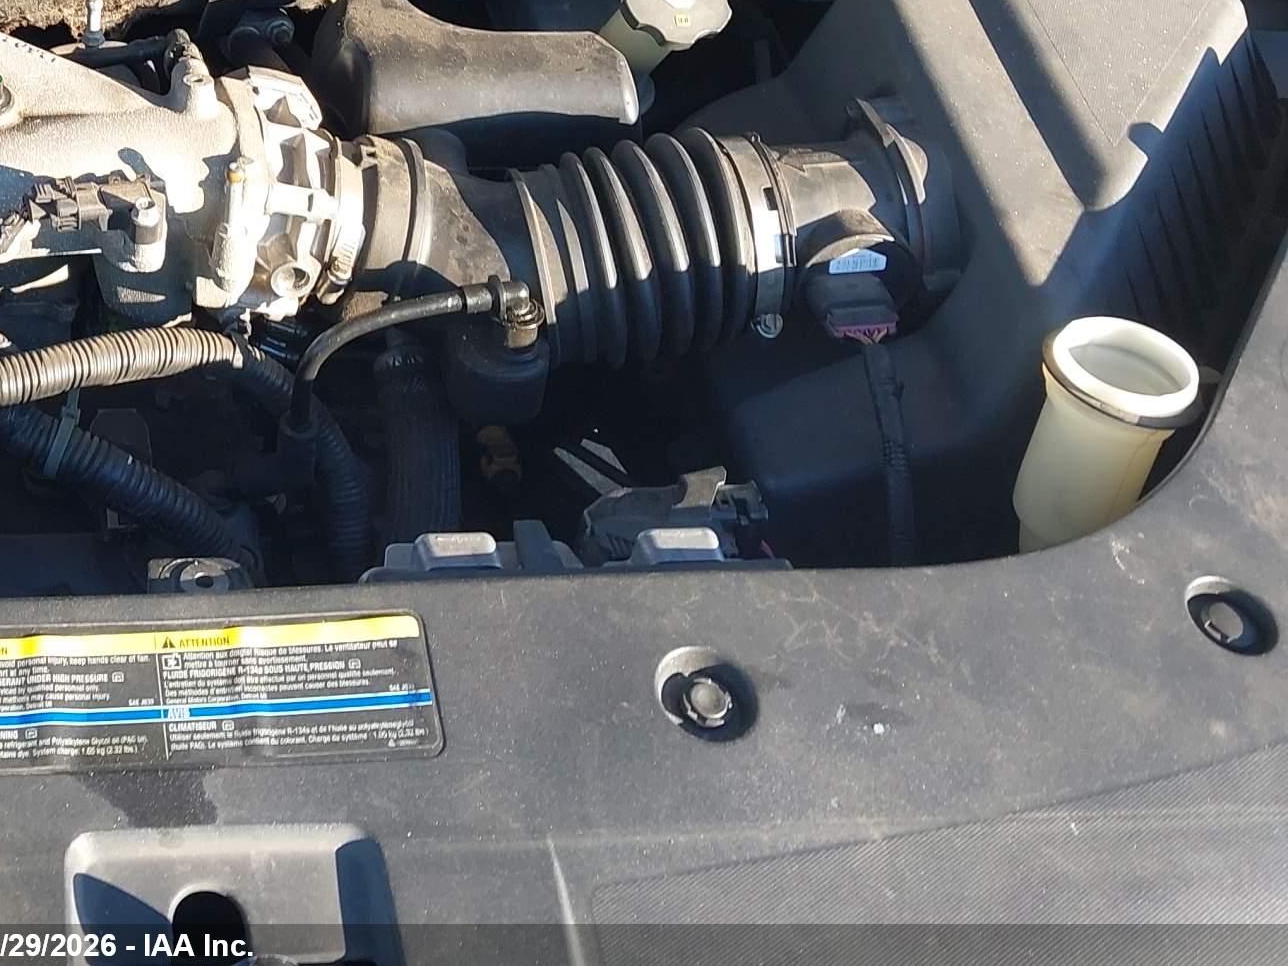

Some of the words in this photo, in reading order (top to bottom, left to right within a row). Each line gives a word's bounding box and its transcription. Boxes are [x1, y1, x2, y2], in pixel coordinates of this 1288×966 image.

[180, 634, 230, 647] ATTENTION
[309, 661, 346, 672] PRESSION
[27, 674, 52, 684] UNDER
[71, 673, 109, 683] PRESSURE
[168, 721, 217, 732] CLIMATISEUR
